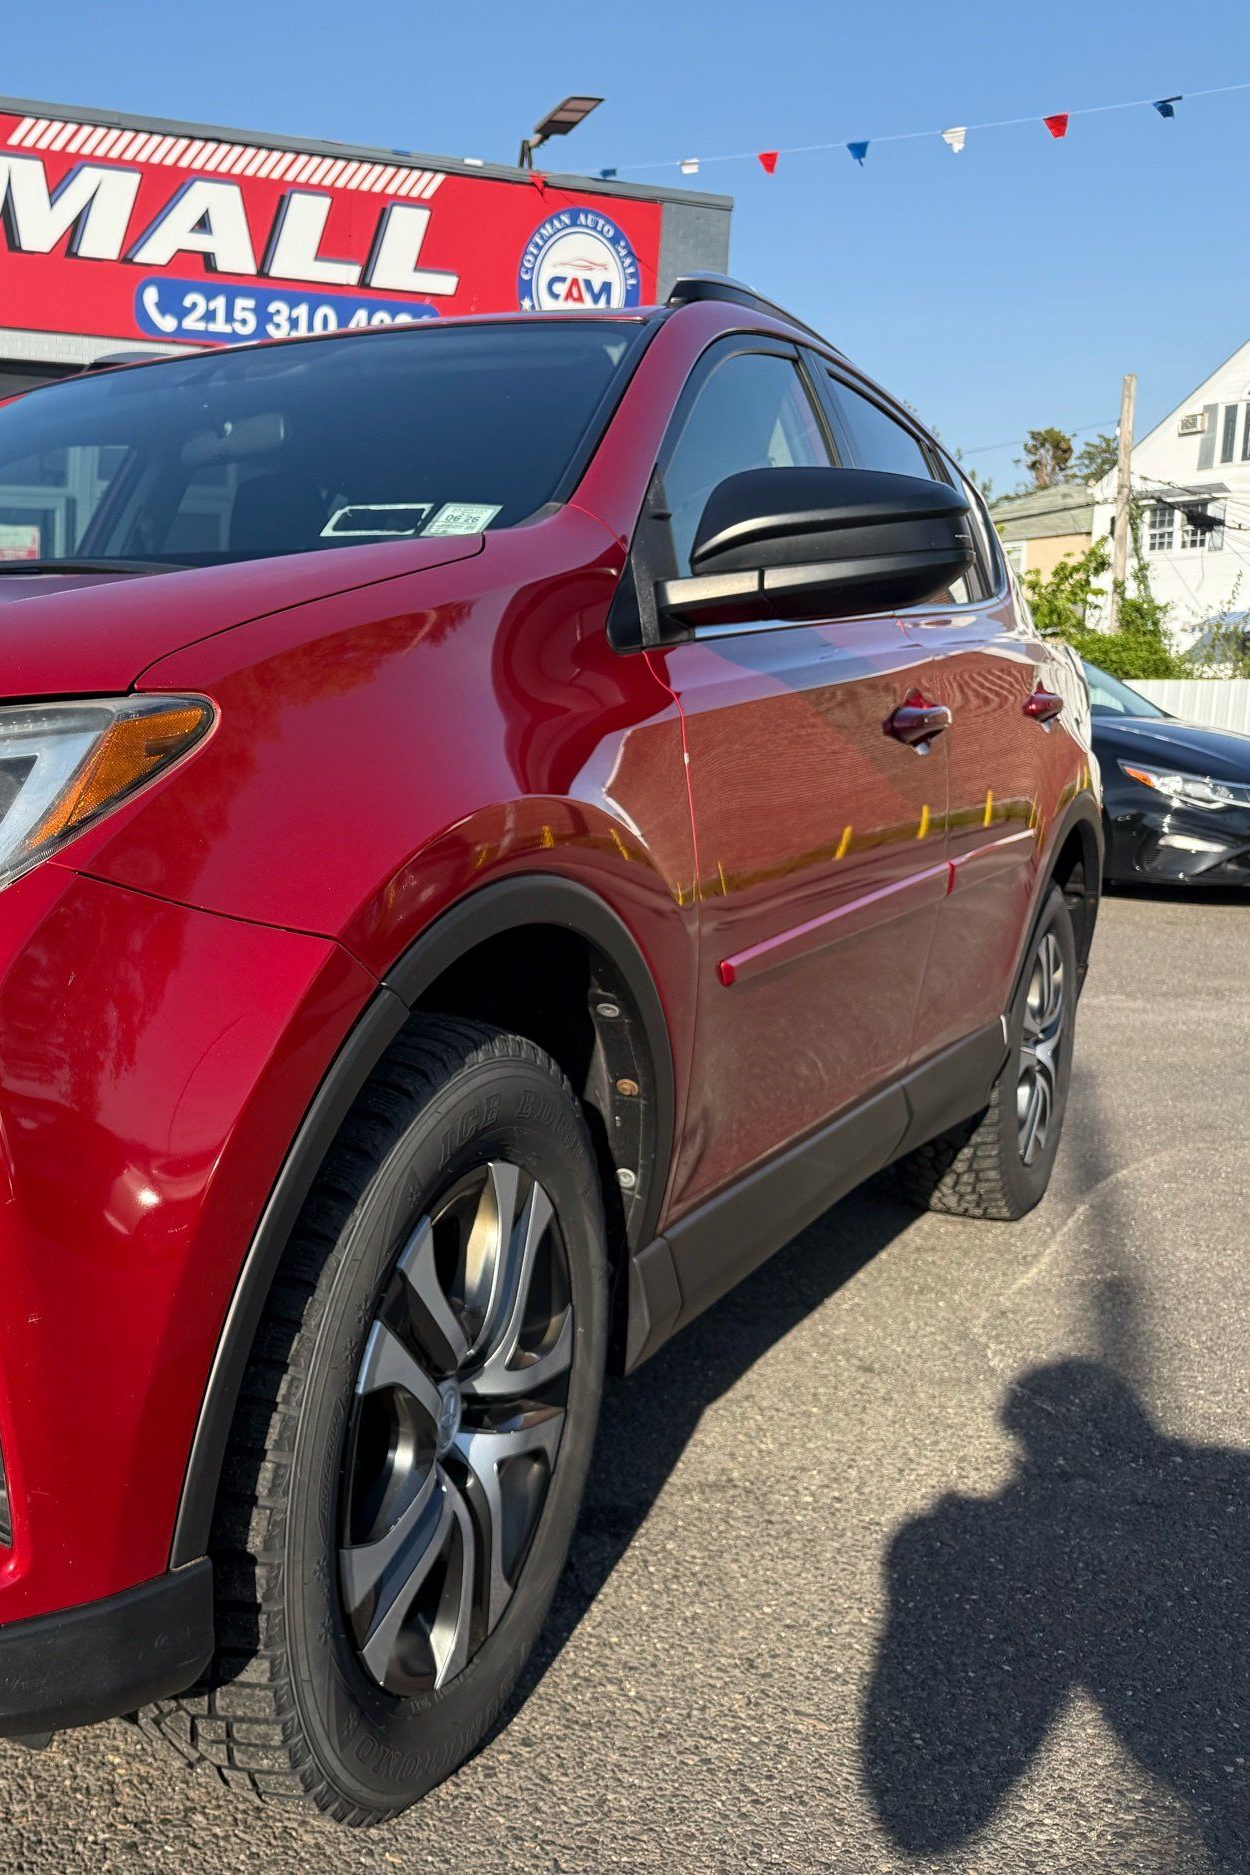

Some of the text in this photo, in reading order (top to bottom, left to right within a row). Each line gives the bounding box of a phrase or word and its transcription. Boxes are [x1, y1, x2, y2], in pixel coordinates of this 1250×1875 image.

[520, 211, 638, 290] COTTMAN AUTO MALL
[181, 291, 257, 335] 215
[265, 299, 338, 339] 310
[547, 275, 612, 308] CAM
